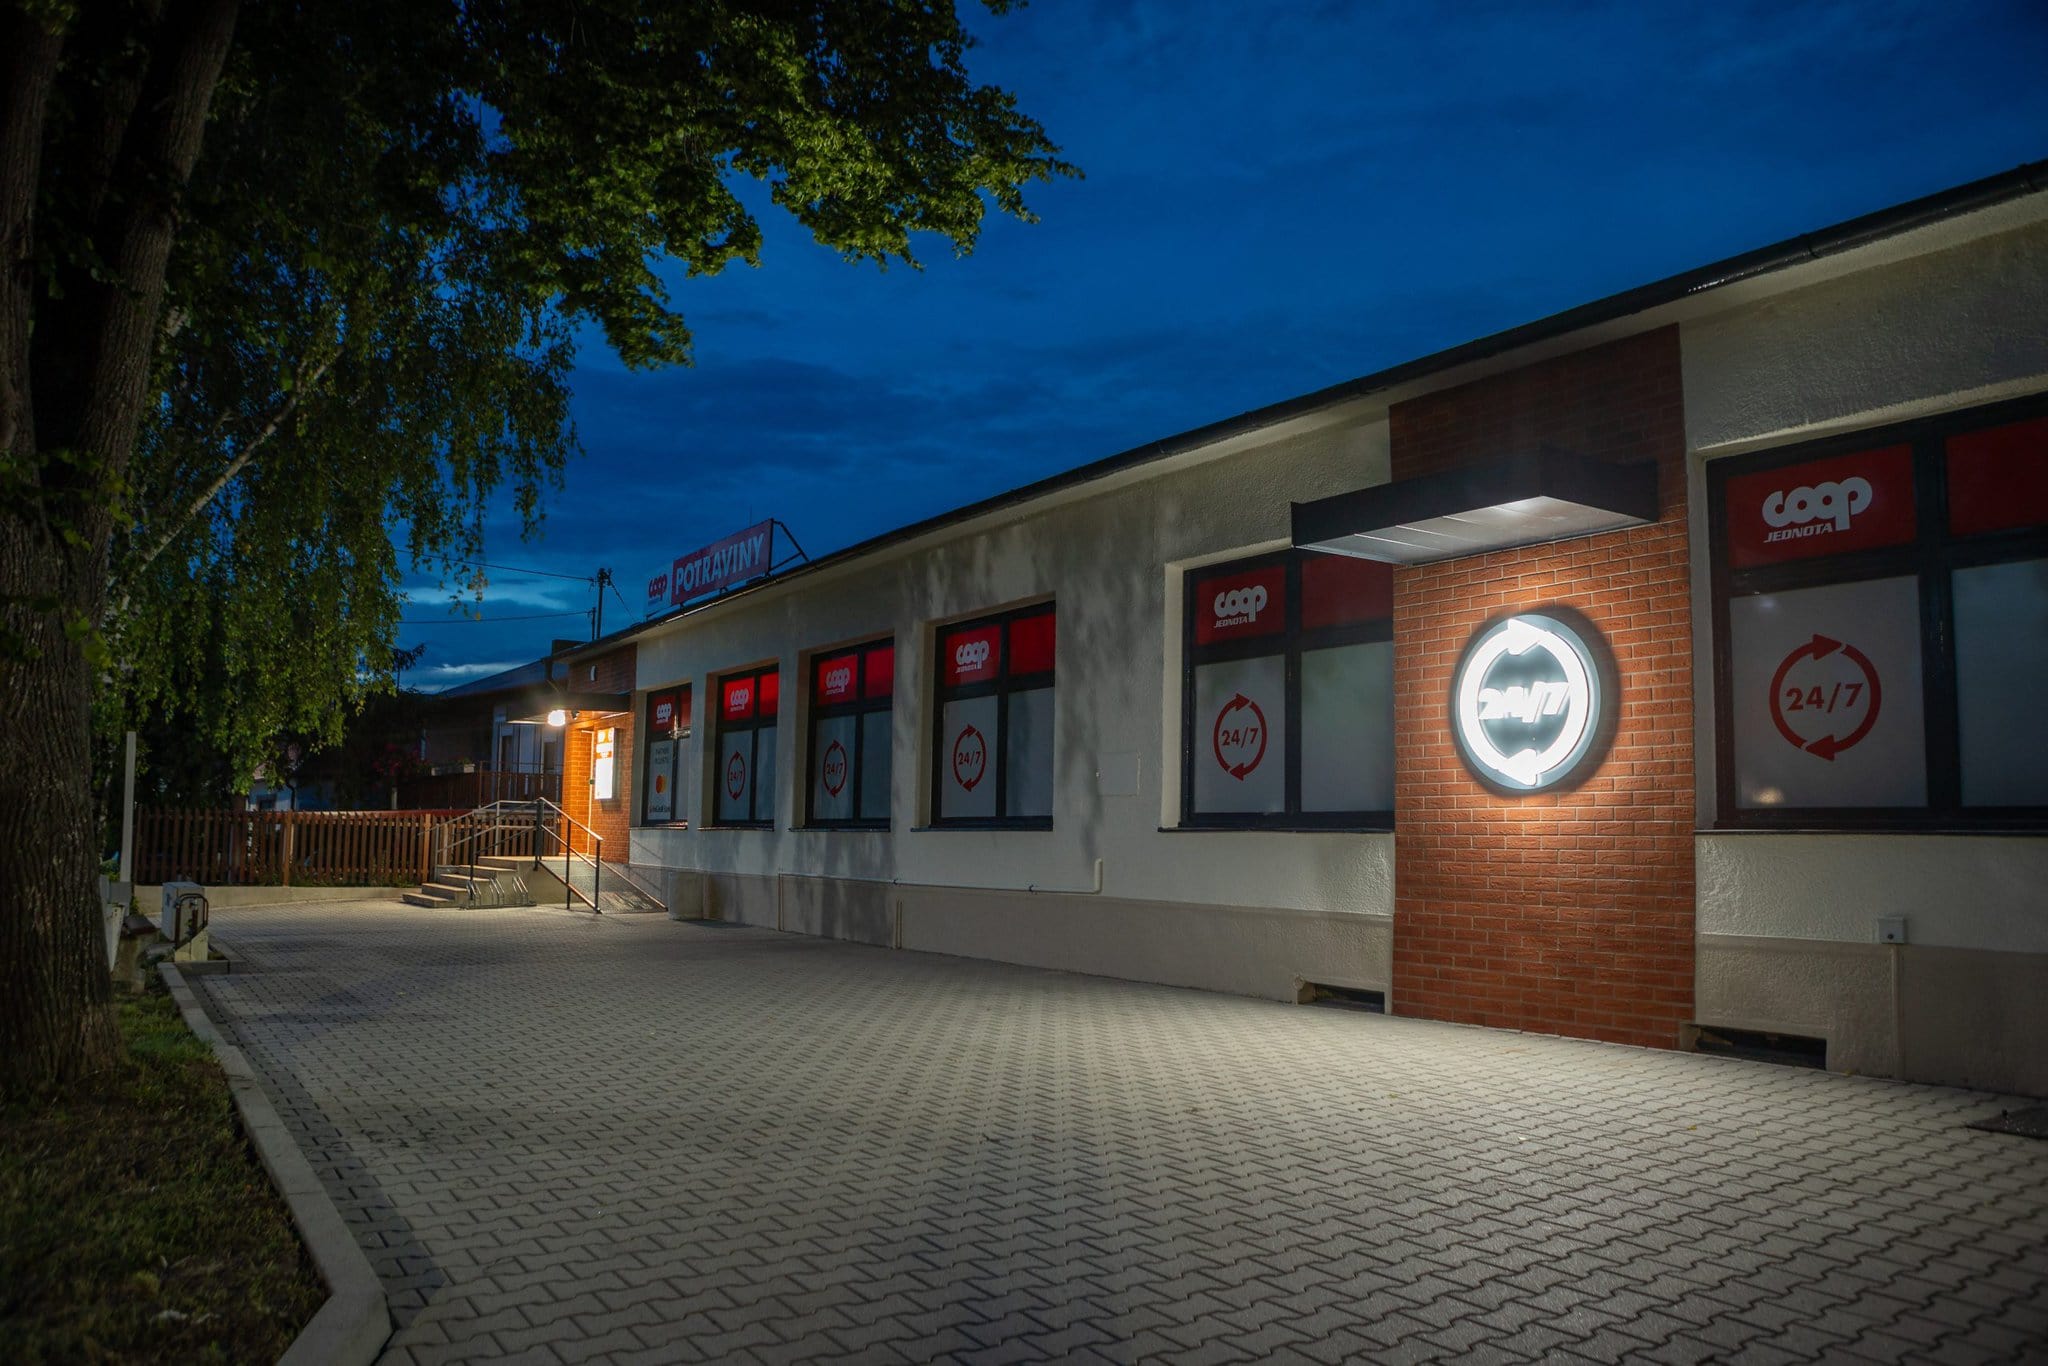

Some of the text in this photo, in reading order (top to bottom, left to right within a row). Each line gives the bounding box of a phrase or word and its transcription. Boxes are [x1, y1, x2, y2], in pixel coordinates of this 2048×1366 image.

[1763, 522, 1833, 543] JEDNOTA
[675, 533, 765, 596] POTRAVINY
[1213, 615, 1248, 629] JEDNOTA
[1477, 681, 1570, 723] 24/7
[1786, 682, 1864, 714] 24/7
[1221, 726, 1259, 749] 24/7
[826, 762, 844, 776] 24/7
[957, 750, 982, 767] 24/7
